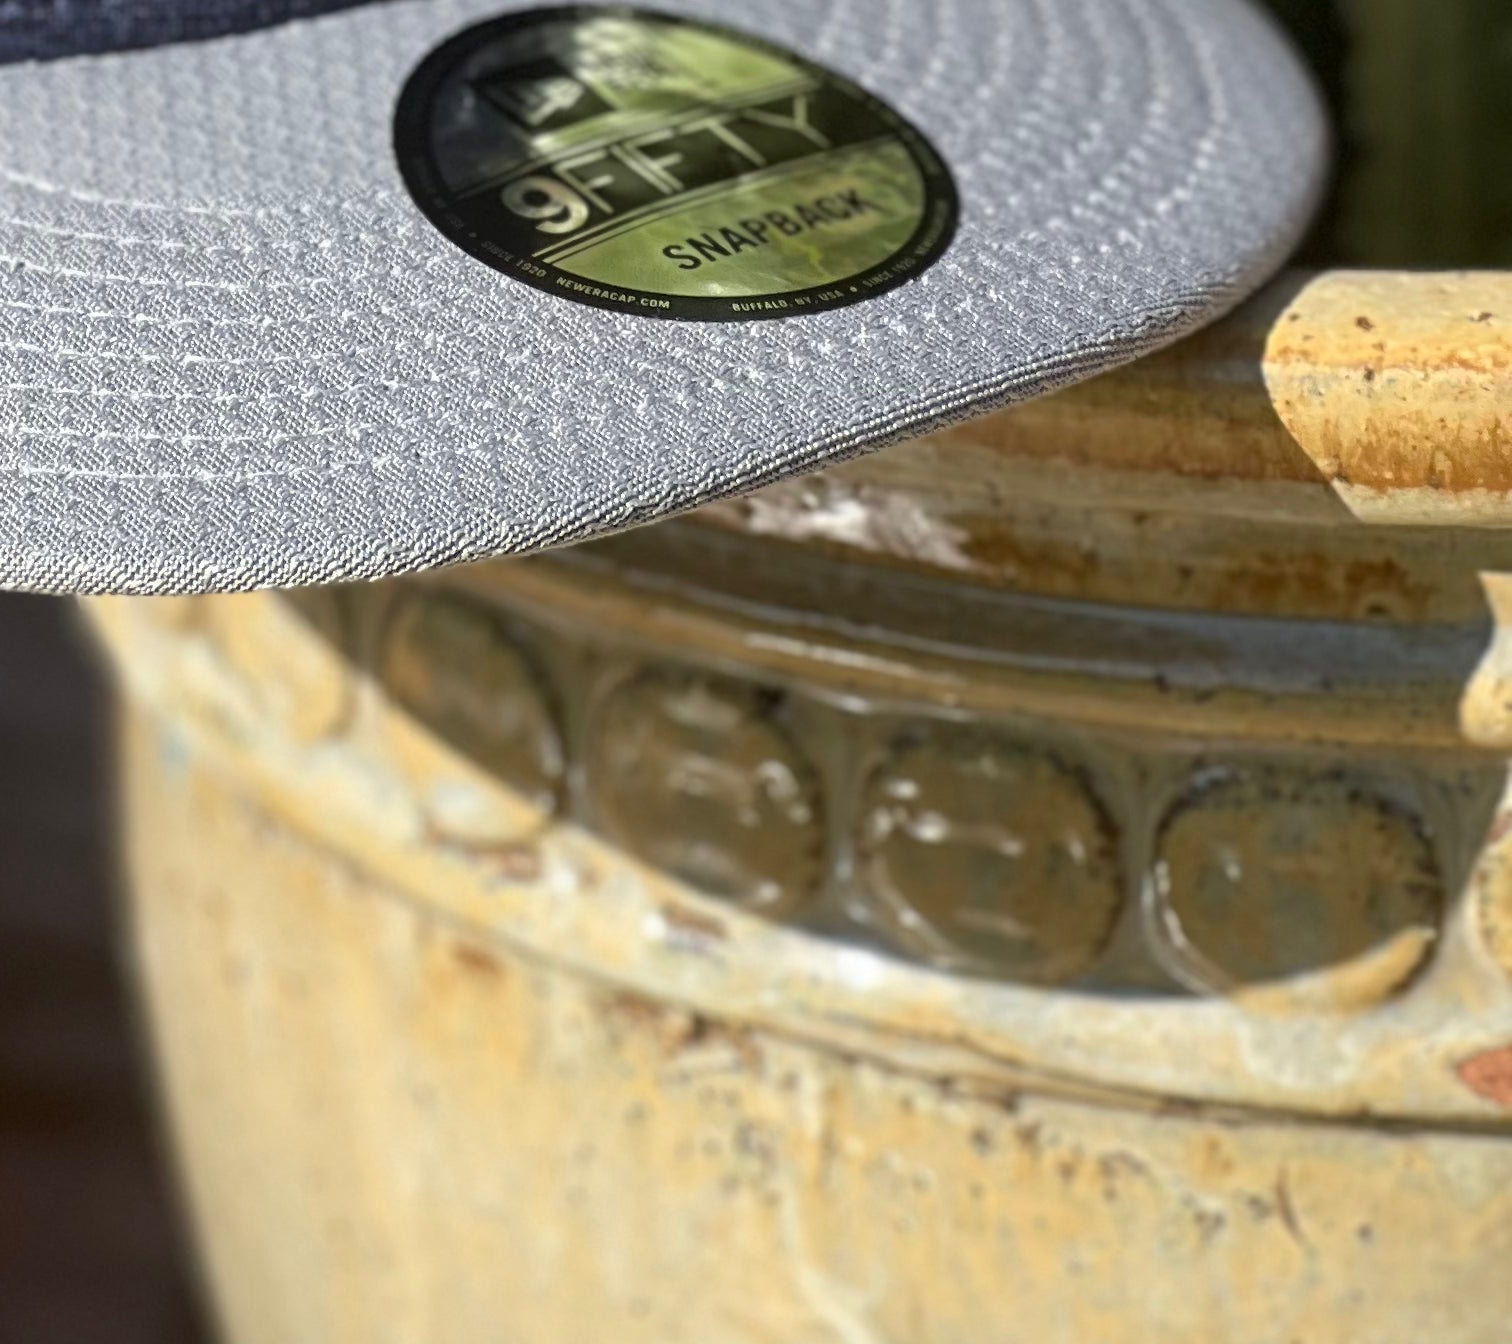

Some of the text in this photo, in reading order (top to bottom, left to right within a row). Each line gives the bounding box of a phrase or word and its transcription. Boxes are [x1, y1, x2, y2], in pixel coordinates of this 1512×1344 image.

[662, 188, 882, 270] SNAPBACK
[516, 259, 547, 279] 1920
[556, 276, 670, 309] NEWERACAP.COM
